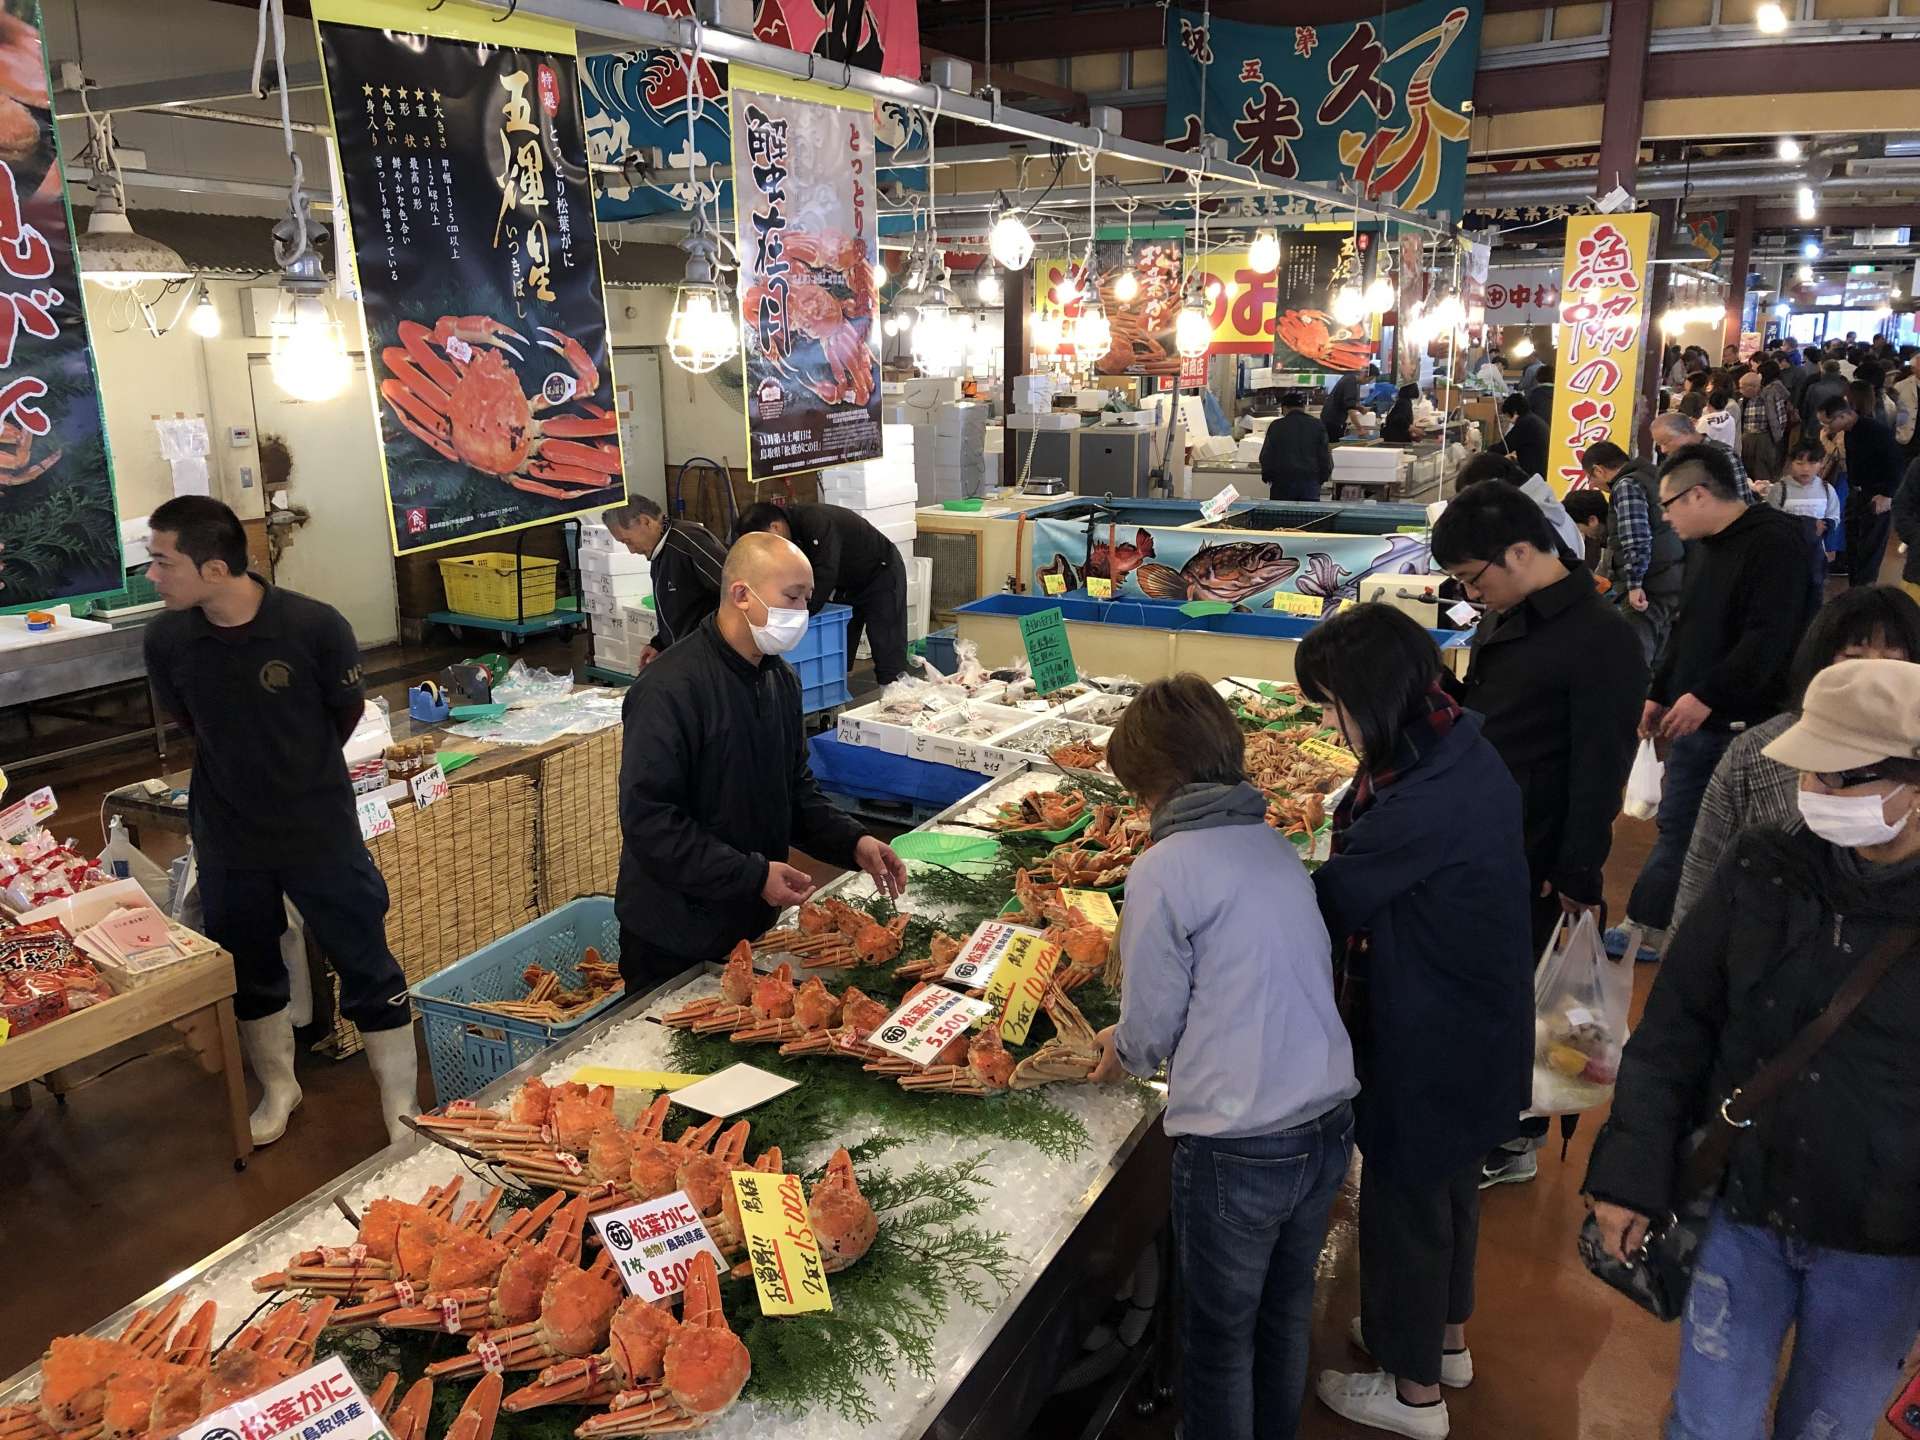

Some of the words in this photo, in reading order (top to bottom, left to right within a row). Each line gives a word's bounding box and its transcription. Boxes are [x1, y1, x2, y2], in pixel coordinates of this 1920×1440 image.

[1180, 17, 1214, 65] 祝
[432, 104, 449, 149] 大きさ
[366, 98, 380, 147] 身入り
[374, 155, 399, 282] ぎっしり詰まっている
[382, 100, 398, 145] 色合い
[391, 156, 411, 246] 鮮やかな色合い
[409, 157, 424, 211] 最高の形
[549, 124, 576, 268] とっとり松葉がに
[505, 223, 528, 320] いつきぼし
[963, 923, 1003, 963] 松葉がに
[898, 989, 952, 1029] 松葉がに
[933, 995, 963, 1018] 鳥取県産
[628, 1203, 697, 1242] 松葉がに
[667, 1227, 706, 1253] 鳥取県産
[621, 1257, 646, 1278] 1枚
[240, 1372, 353, 1440] 松葉がに
[302, 1401, 365, 1440] 鳥取県産
